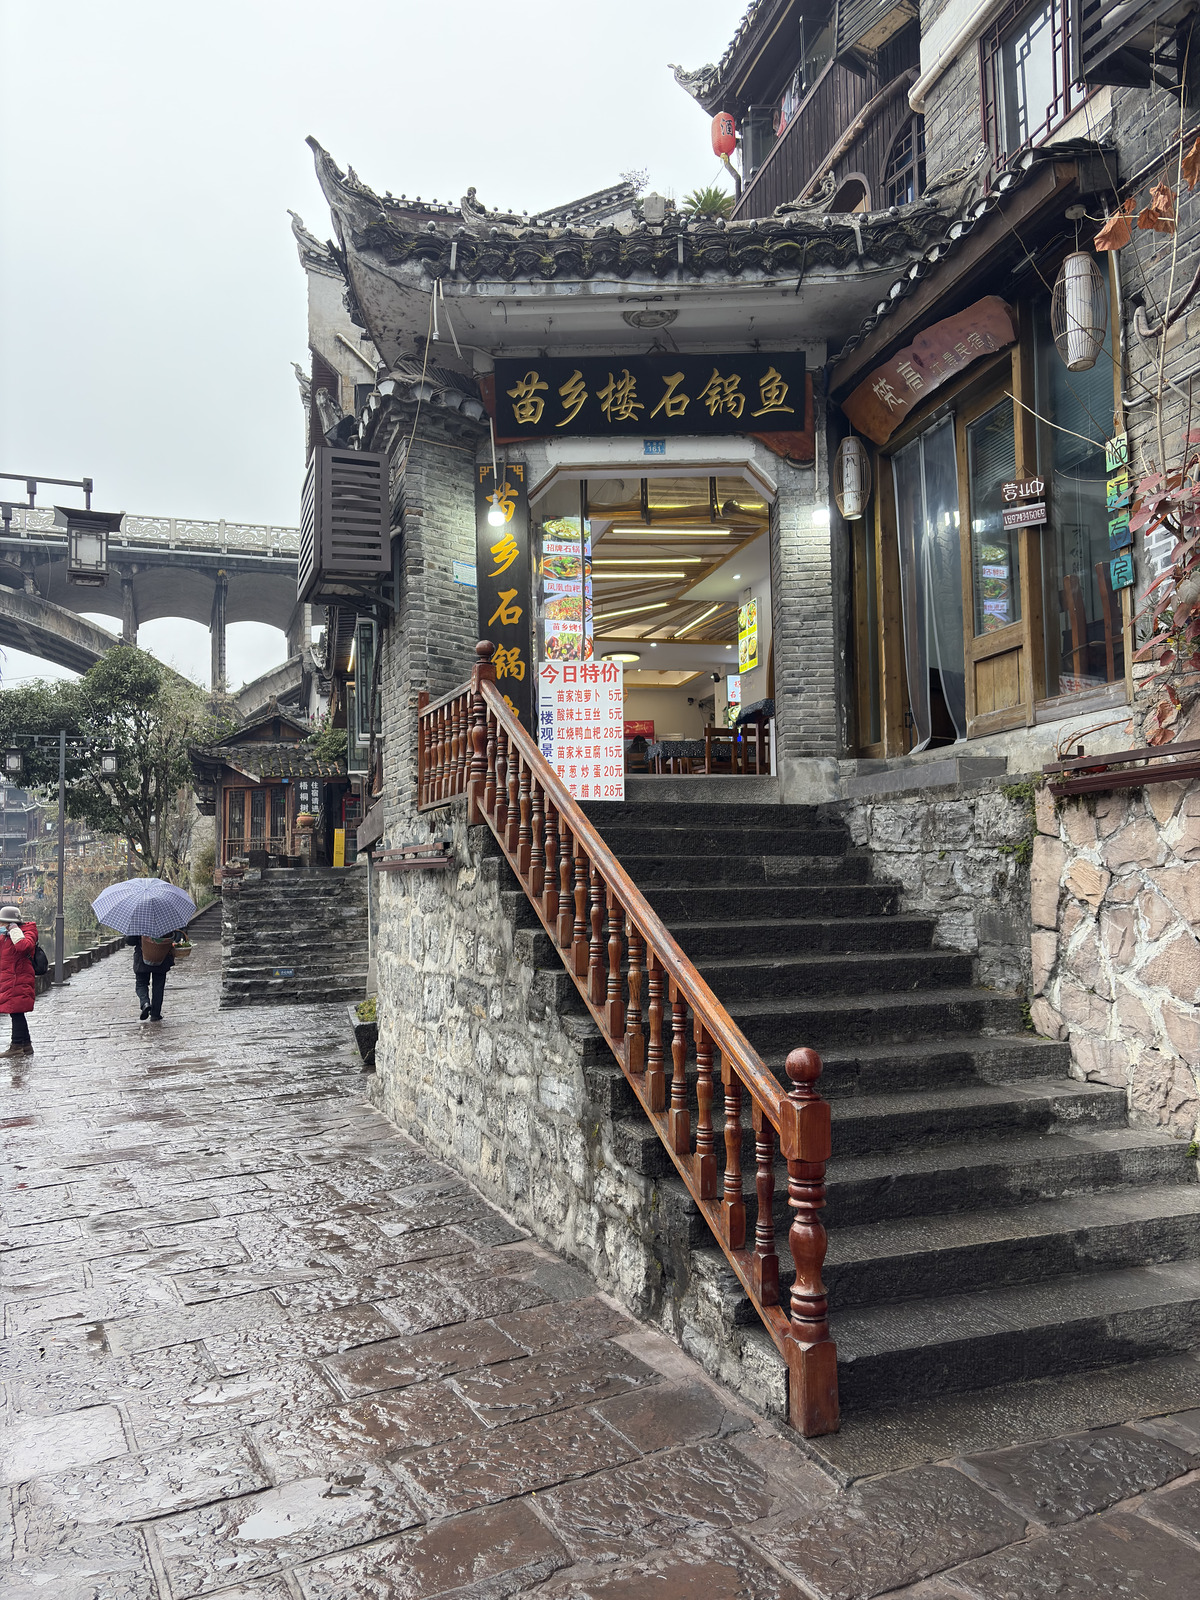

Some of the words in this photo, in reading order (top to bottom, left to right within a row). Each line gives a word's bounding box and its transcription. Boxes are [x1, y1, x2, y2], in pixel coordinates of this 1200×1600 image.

[720, 117, 734, 137] 酒
[928, 331, 985, 378] 江景民宿
[506, 366, 796, 427] 苗乡楼石锅鱼
[1002, 477, 1045, 501] 营业中
[540, 662, 620, 684] 今日特价
[556, 689, 601, 703] 苗家泡萝卜
[608, 688, 622, 702] 5元
[556, 707, 601, 721] 酸辣土豆丝
[608, 707, 623, 721] 5元
[540, 696, 554, 767] 二楼观景
[556, 726, 602, 740] 红烧鸭血粑
[603, 726, 623, 739] 28元
[556, 745, 602, 760] 苗家米豆腐
[604, 745, 623, 759] 15元
[556, 764, 602, 779] 野葱炒蛋
[603, 764, 623, 778] 20元
[299, 781, 309, 812] 梧桐树
[310, 781, 320, 813] 住宿请进
[604, 783, 623, 798] 28元
